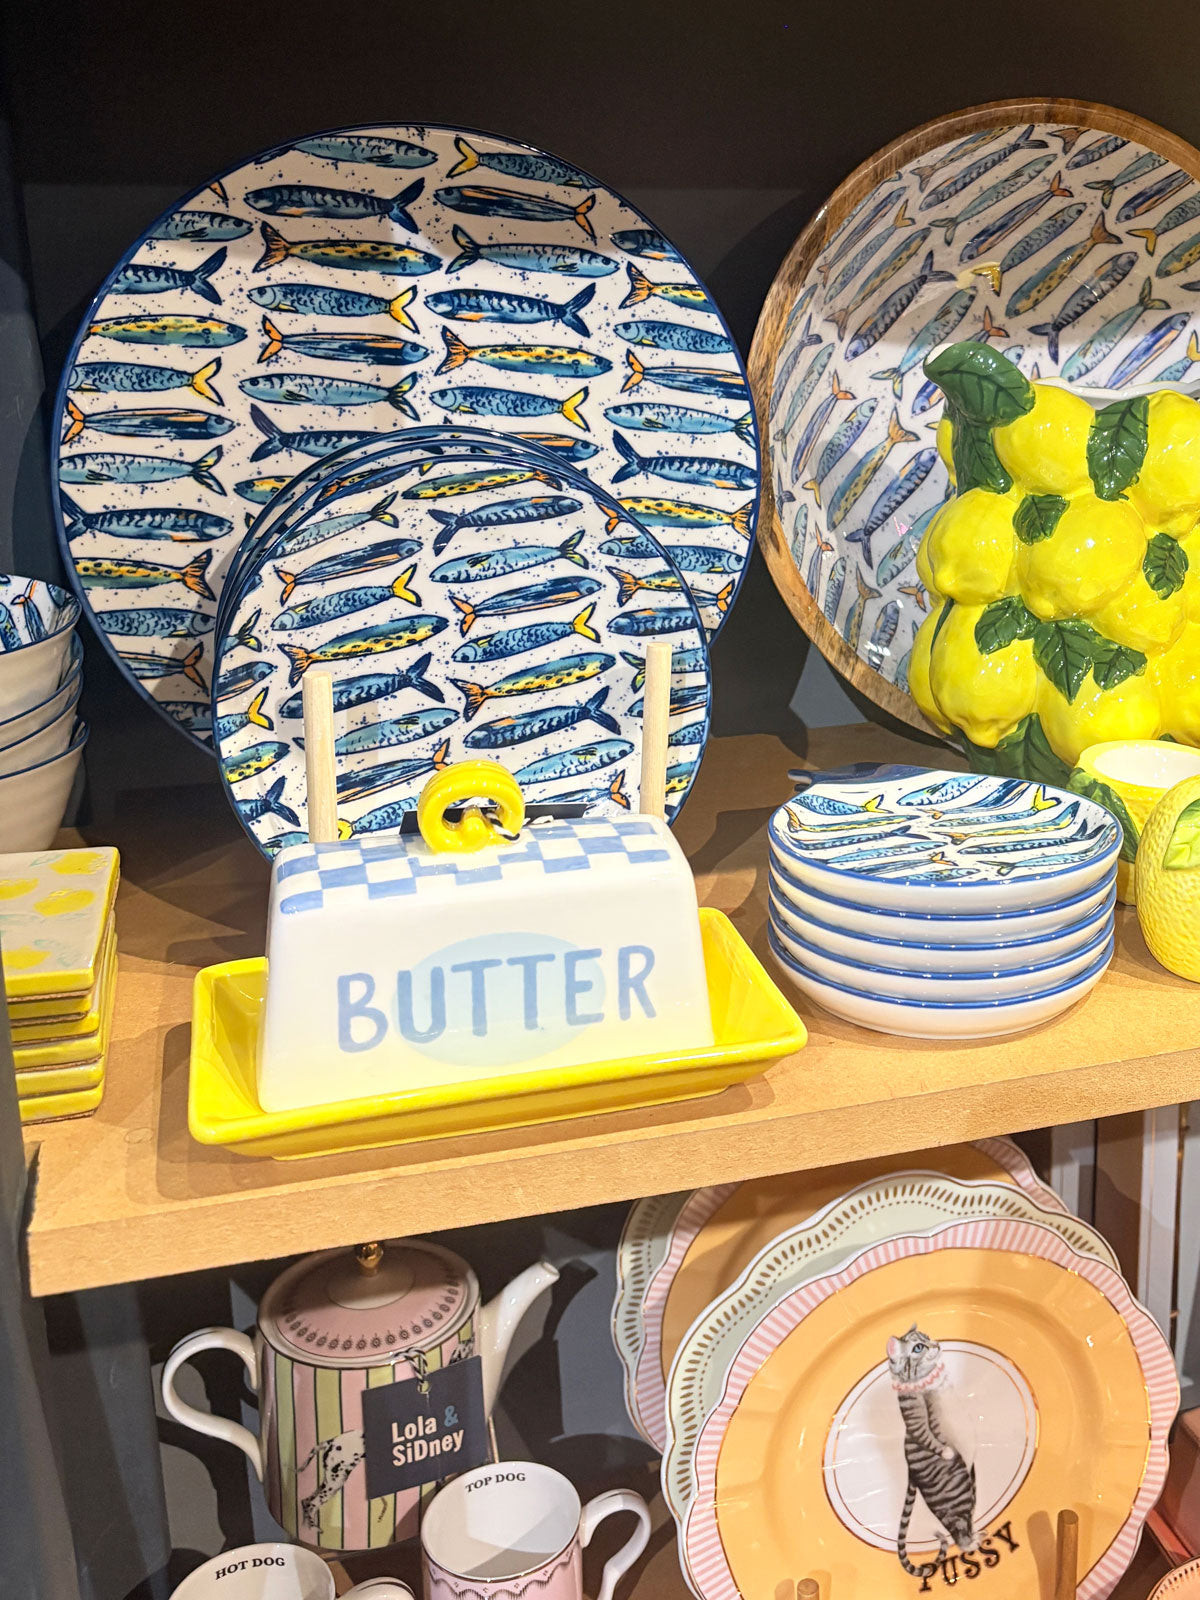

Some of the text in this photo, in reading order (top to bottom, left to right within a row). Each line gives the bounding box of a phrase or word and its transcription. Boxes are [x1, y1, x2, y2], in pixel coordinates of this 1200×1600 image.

[337, 945, 656, 1053] BUTTER
[392, 1405, 459, 1443] Lola &
[392, 1429, 464, 1467] SiDney
[465, 1472, 526, 1493] TOP DOG
[215, 1557, 286, 1580] HOT DOG
[919, 1520, 1020, 1593] PUSSY
